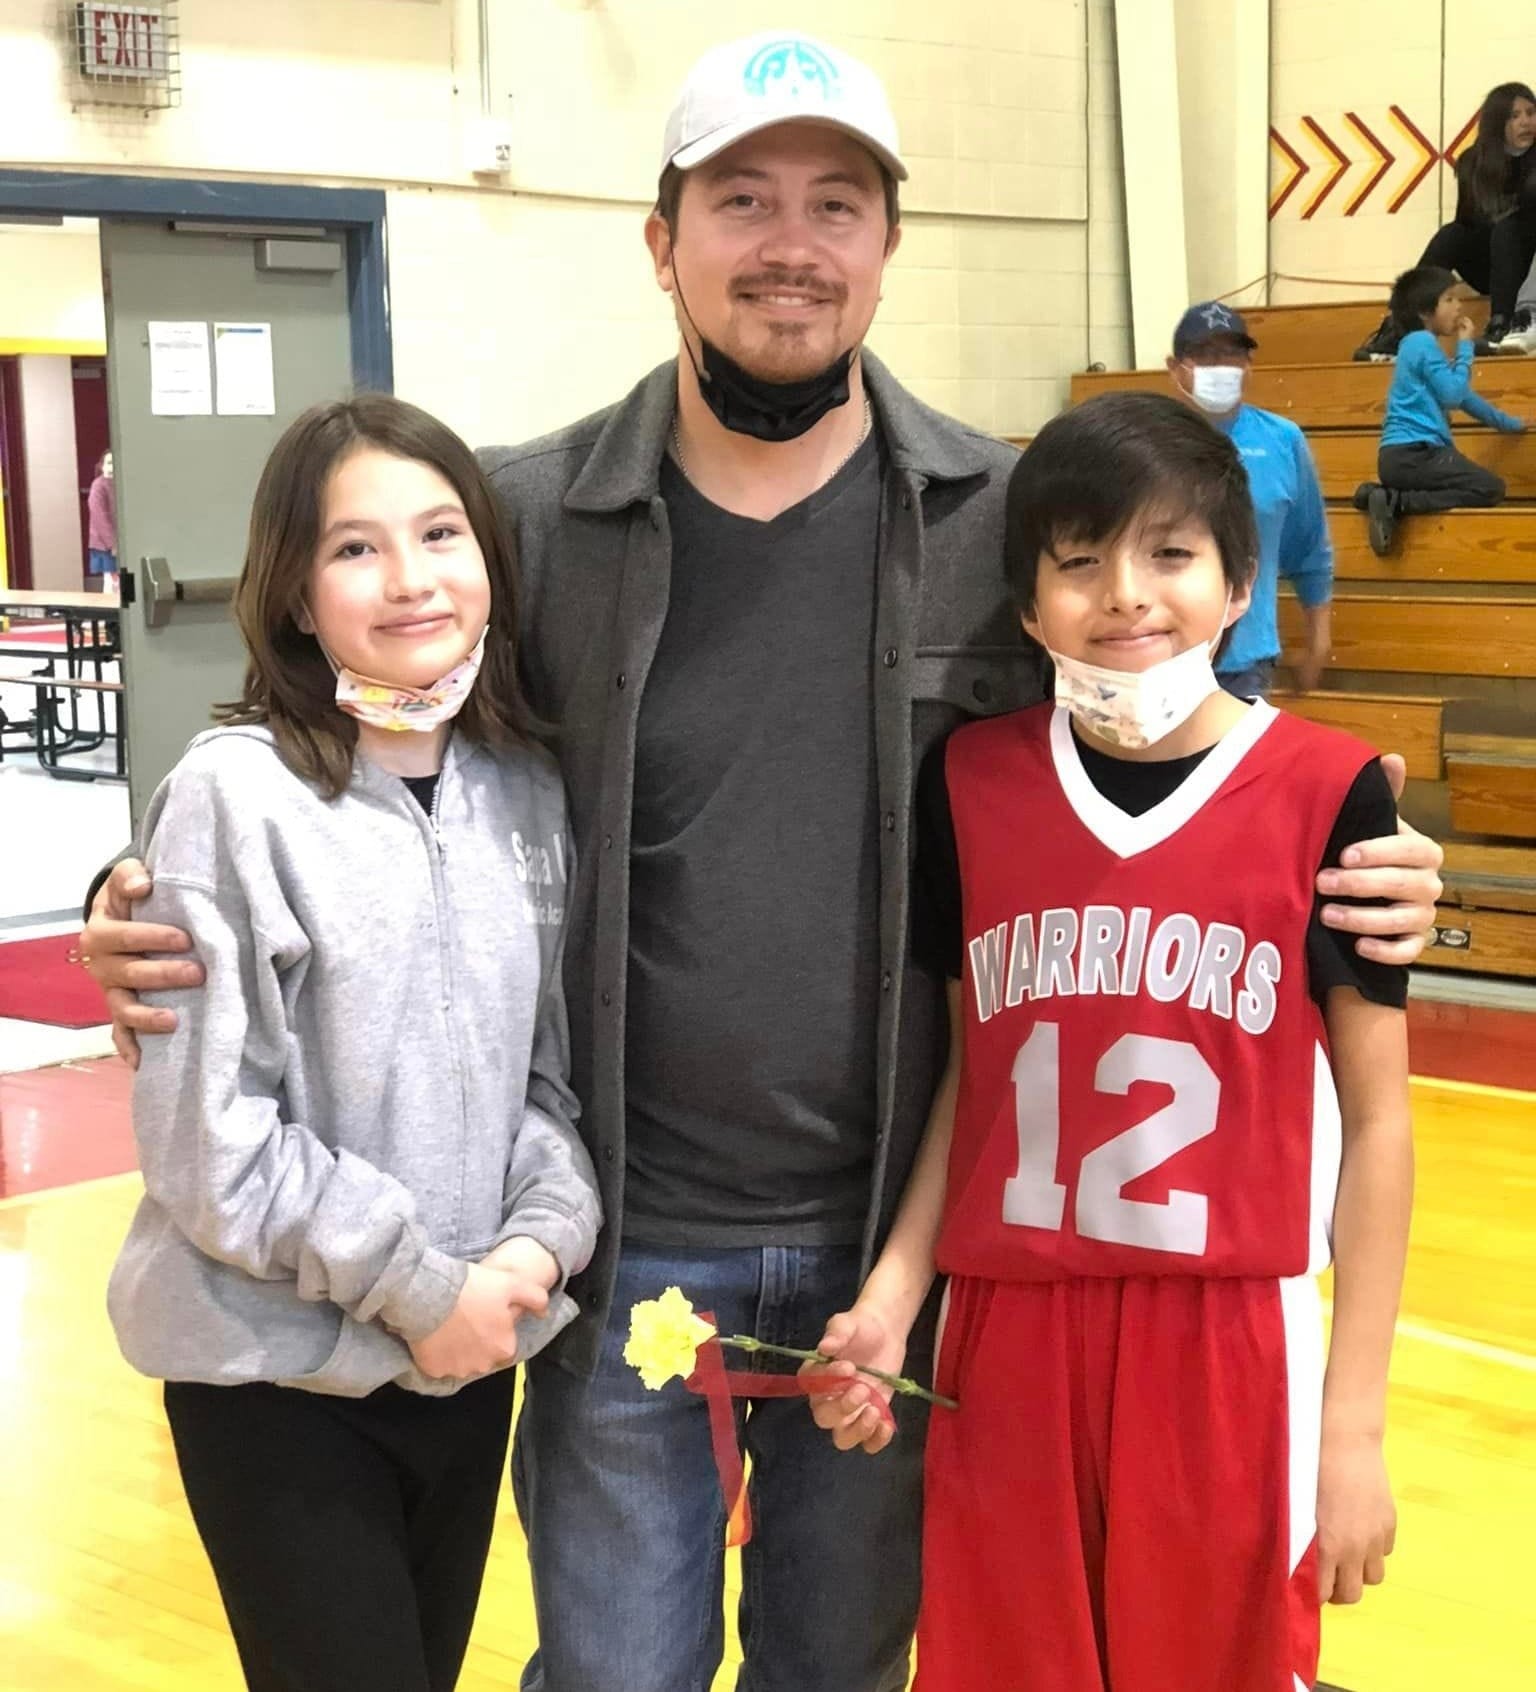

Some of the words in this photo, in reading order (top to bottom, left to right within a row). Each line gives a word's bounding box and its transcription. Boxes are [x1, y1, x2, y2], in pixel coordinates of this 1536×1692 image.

[94, 10, 158, 68] EXIT
[968, 905, 1282, 1035] WARRIORS
[1002, 1021, 1222, 1256] 12
